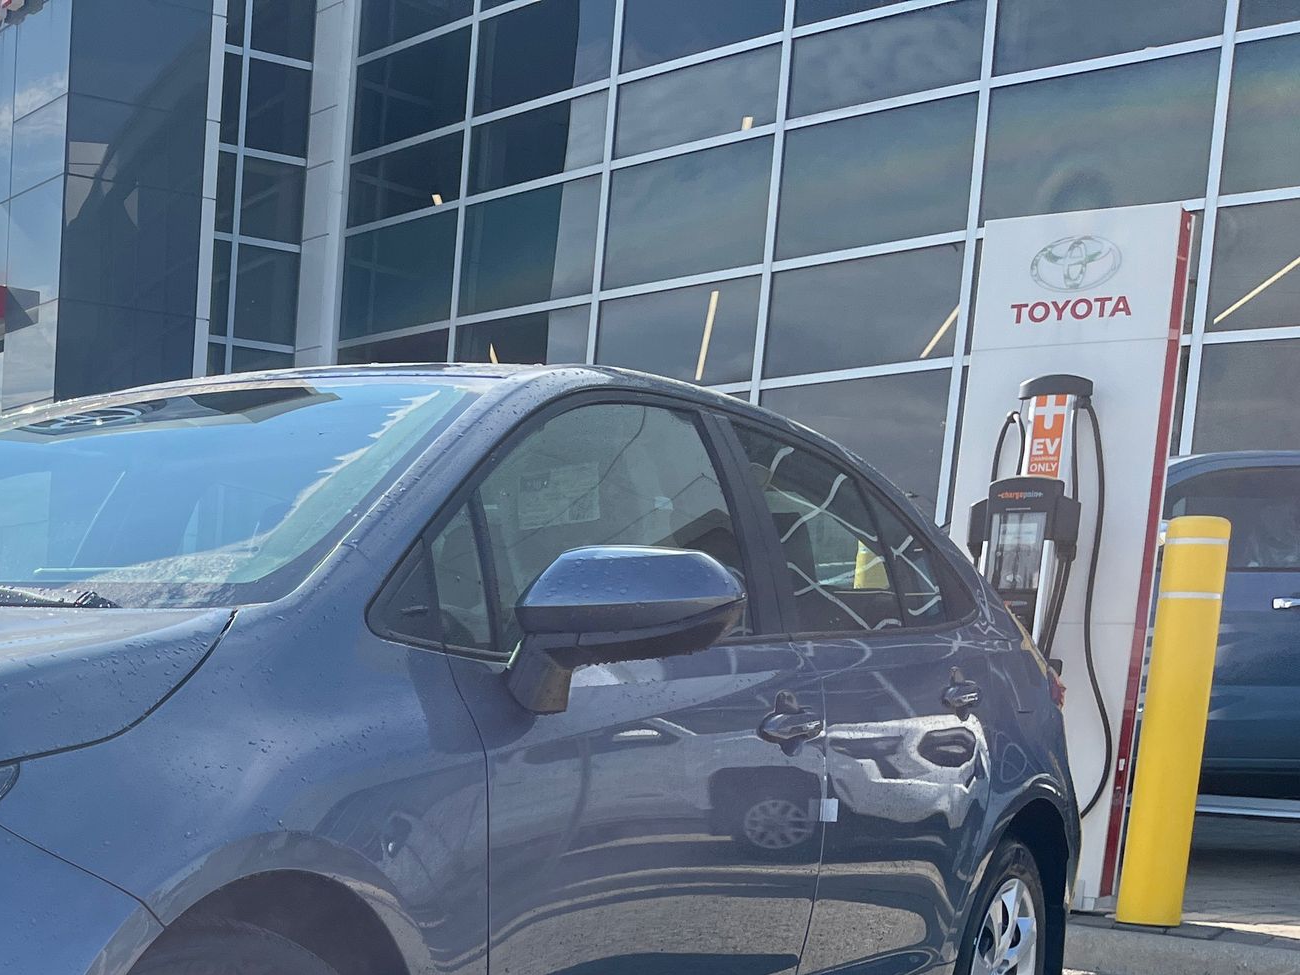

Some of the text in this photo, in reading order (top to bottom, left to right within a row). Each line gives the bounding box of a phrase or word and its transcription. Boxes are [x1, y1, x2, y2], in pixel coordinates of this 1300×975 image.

[1011, 296, 1132, 324] TOYOTA
[1032, 438, 1061, 455] EV
[1029, 463, 1058, 472] ONLY
